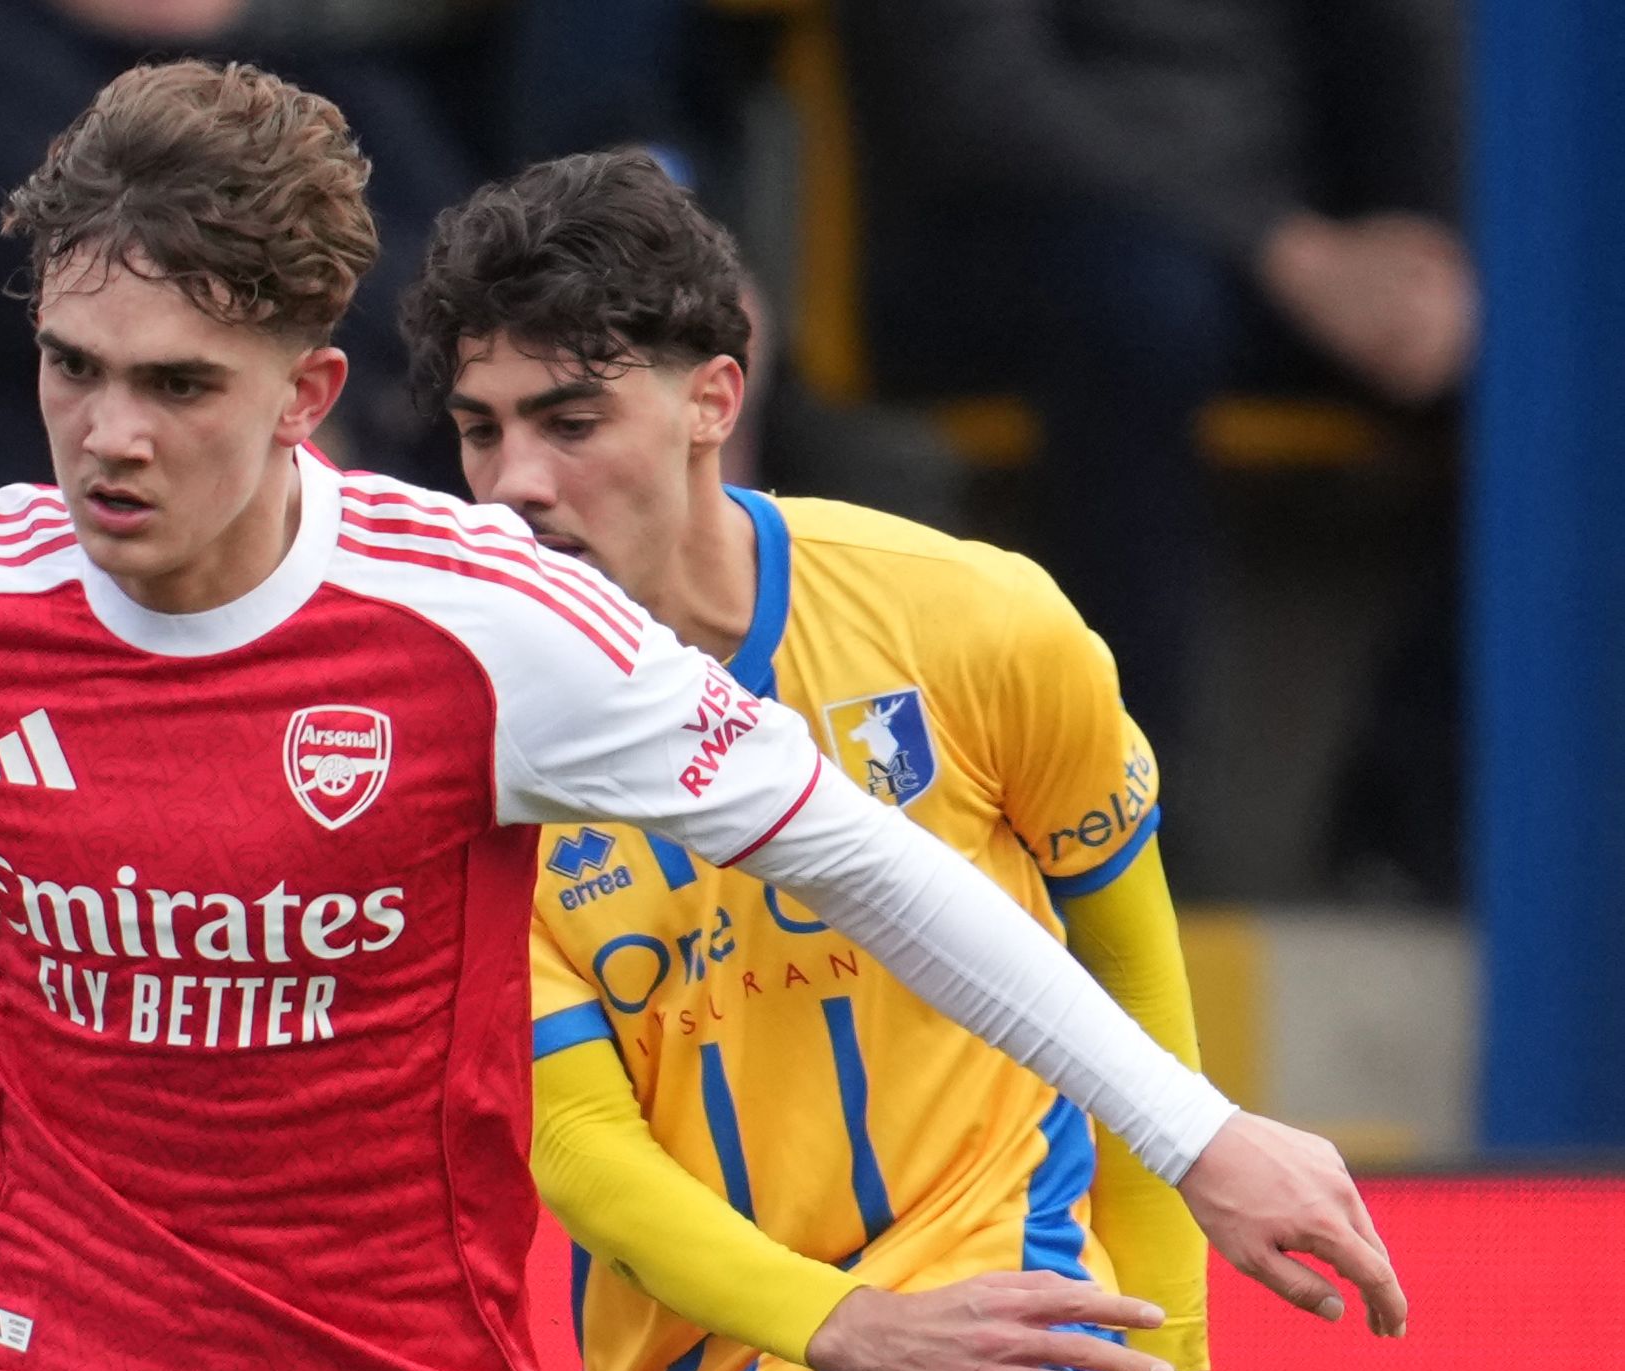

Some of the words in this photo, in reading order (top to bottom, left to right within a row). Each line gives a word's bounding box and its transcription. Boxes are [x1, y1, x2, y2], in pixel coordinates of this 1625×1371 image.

[300, 723, 377, 749] Arsenal
[678, 686, 762, 798] RWAN
[558, 864, 633, 911] errea
[38, 954, 110, 1034] FLY
[129, 972, 338, 1048] BETTER
